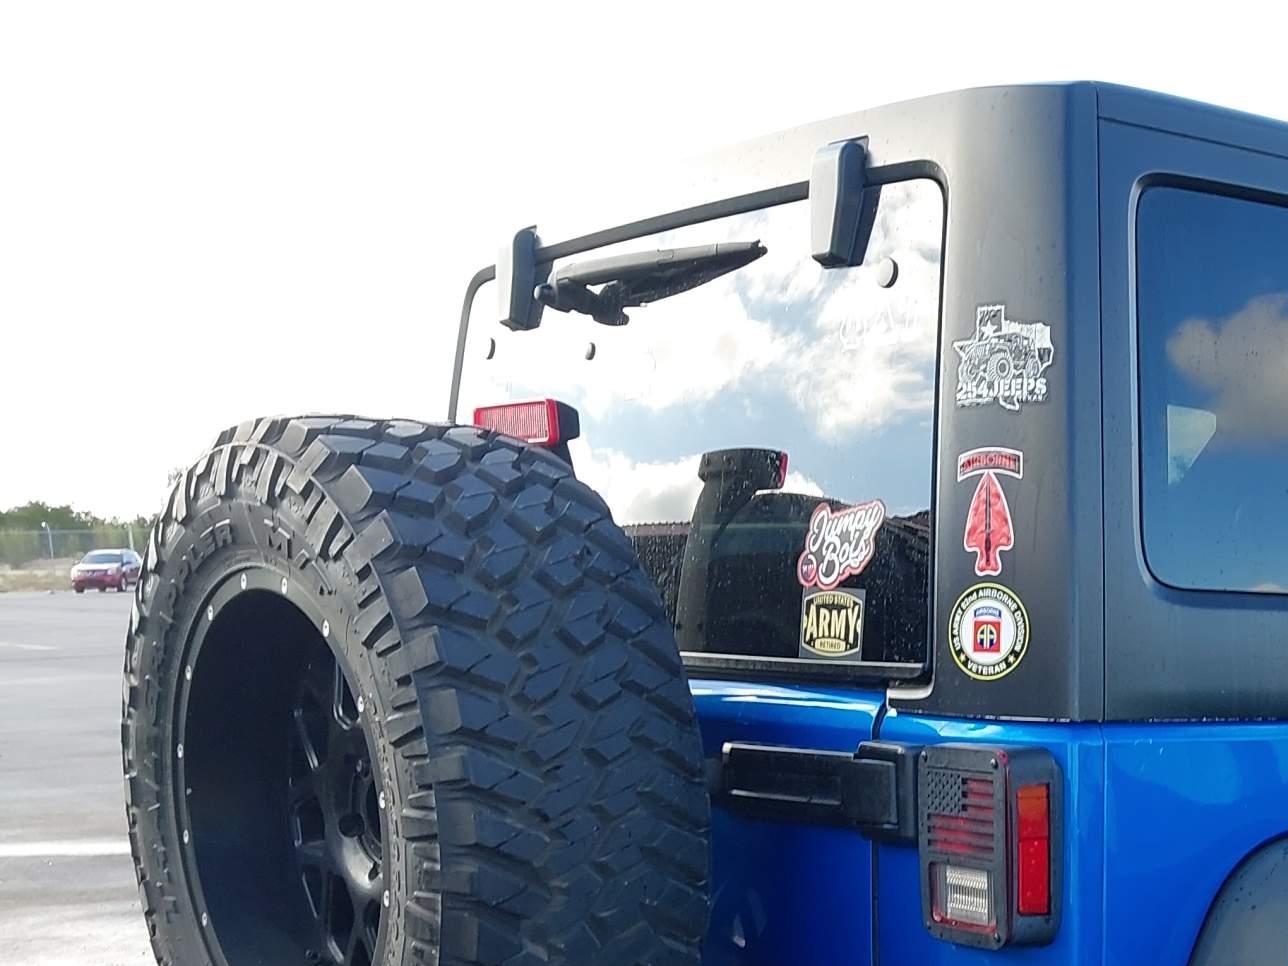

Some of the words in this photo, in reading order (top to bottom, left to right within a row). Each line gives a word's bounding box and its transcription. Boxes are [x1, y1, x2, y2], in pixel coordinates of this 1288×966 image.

[805, 603, 860, 645] ARMY
[978, 588, 1018, 611] AIRBORNE
[1013, 610, 1026, 652] DIVISION
[967, 660, 1007, 676] VETERAN
